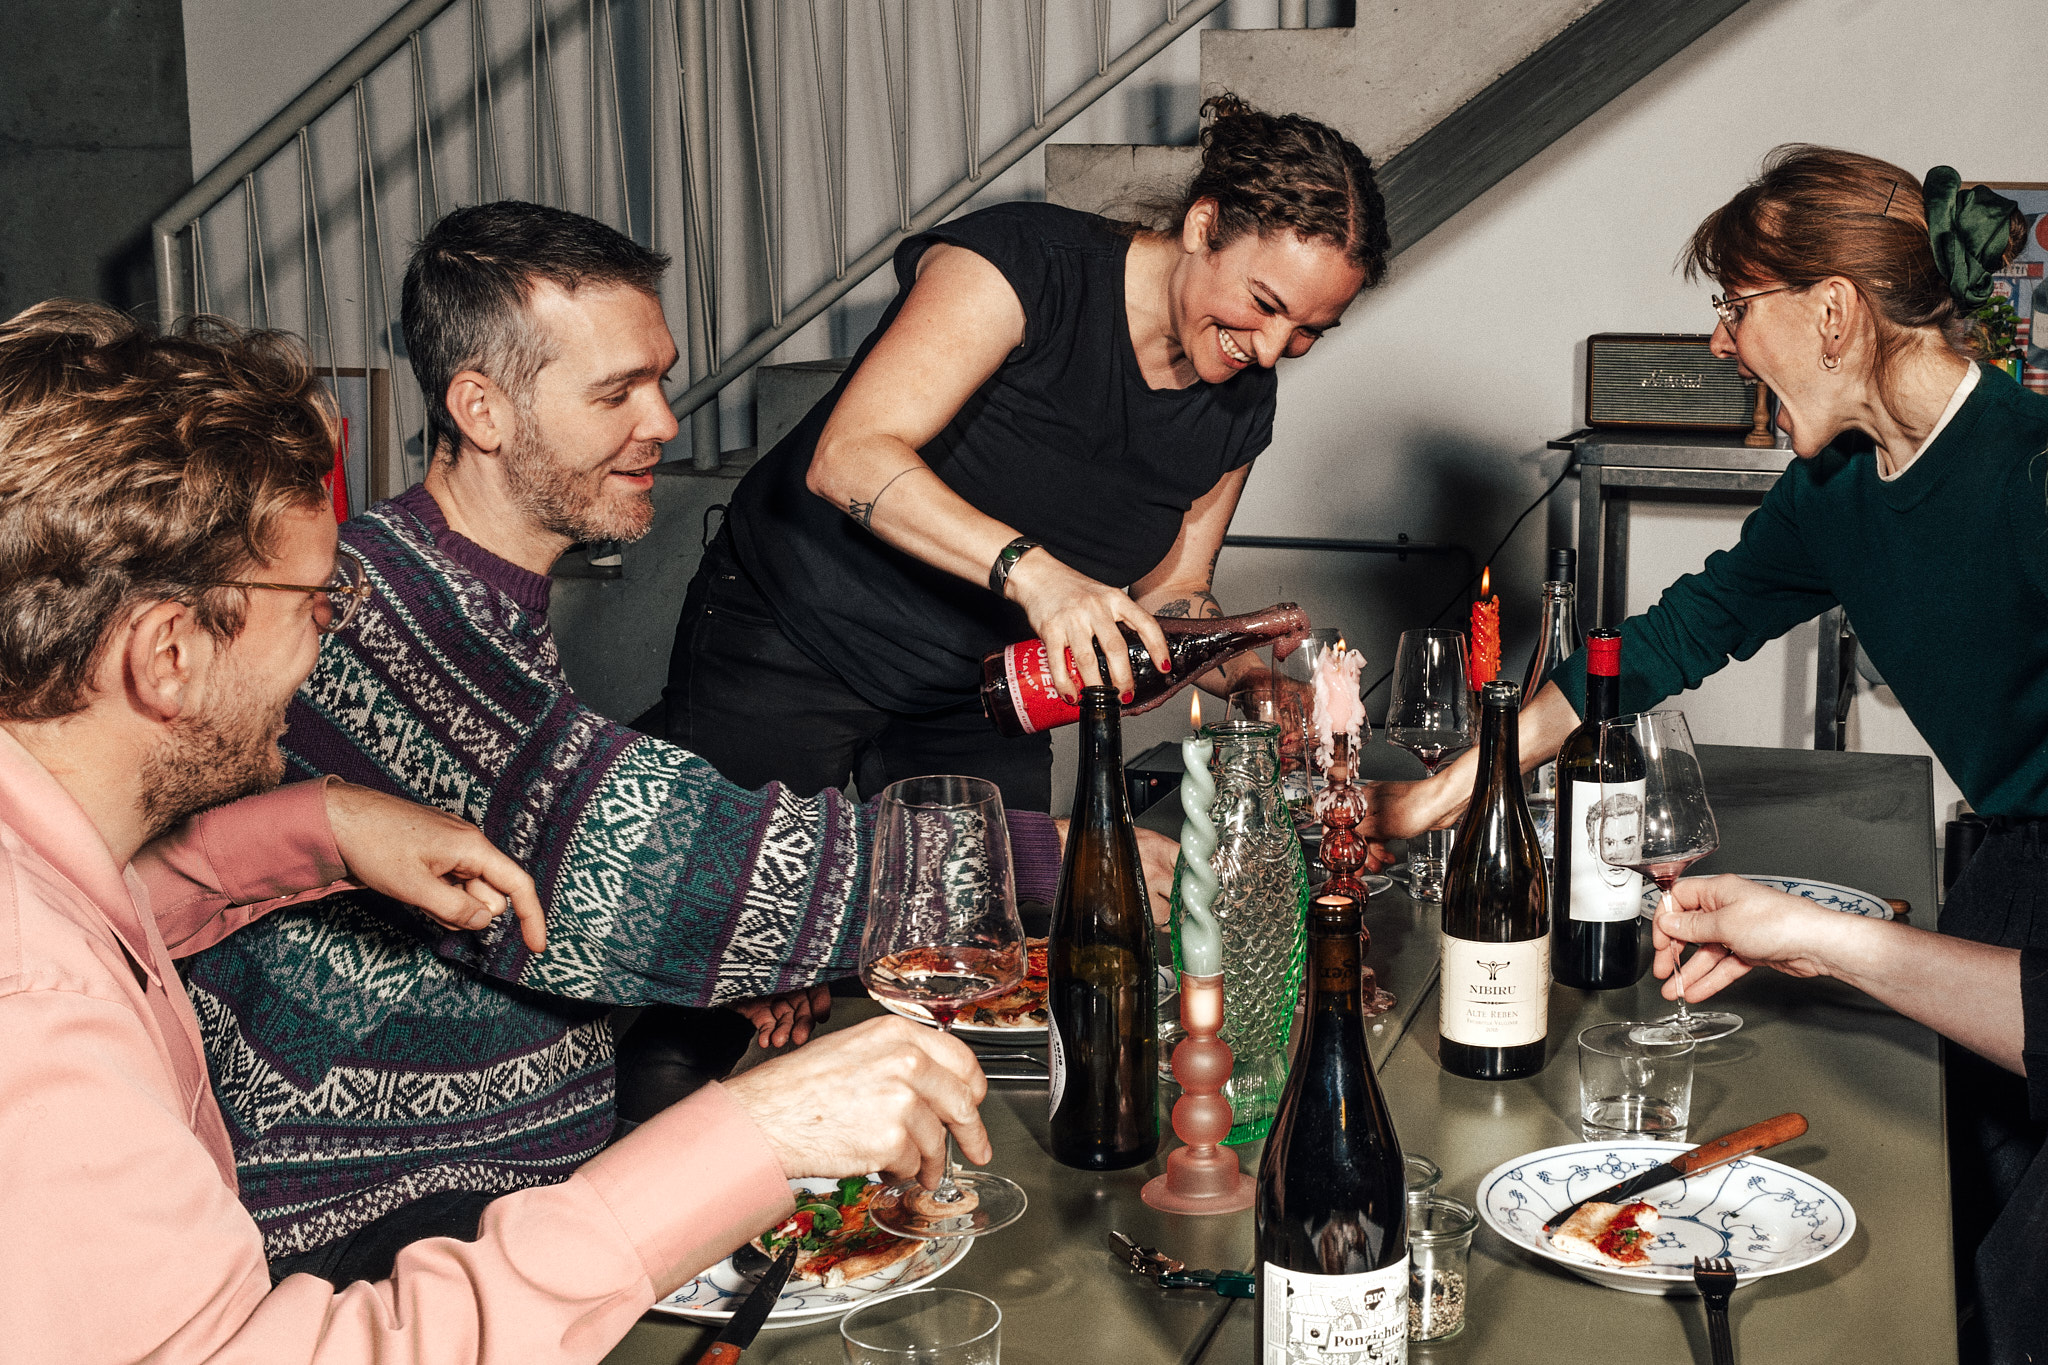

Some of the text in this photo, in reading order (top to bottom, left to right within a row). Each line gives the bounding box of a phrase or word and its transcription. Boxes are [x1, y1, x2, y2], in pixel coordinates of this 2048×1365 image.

[1469, 984, 1517, 995] NIBIRU
[1466, 1008, 1519, 1019] ALTE REBEN
[1365, 1290, 1386, 1305] BIO
[1334, 1321, 1404, 1347] Ponzichter
